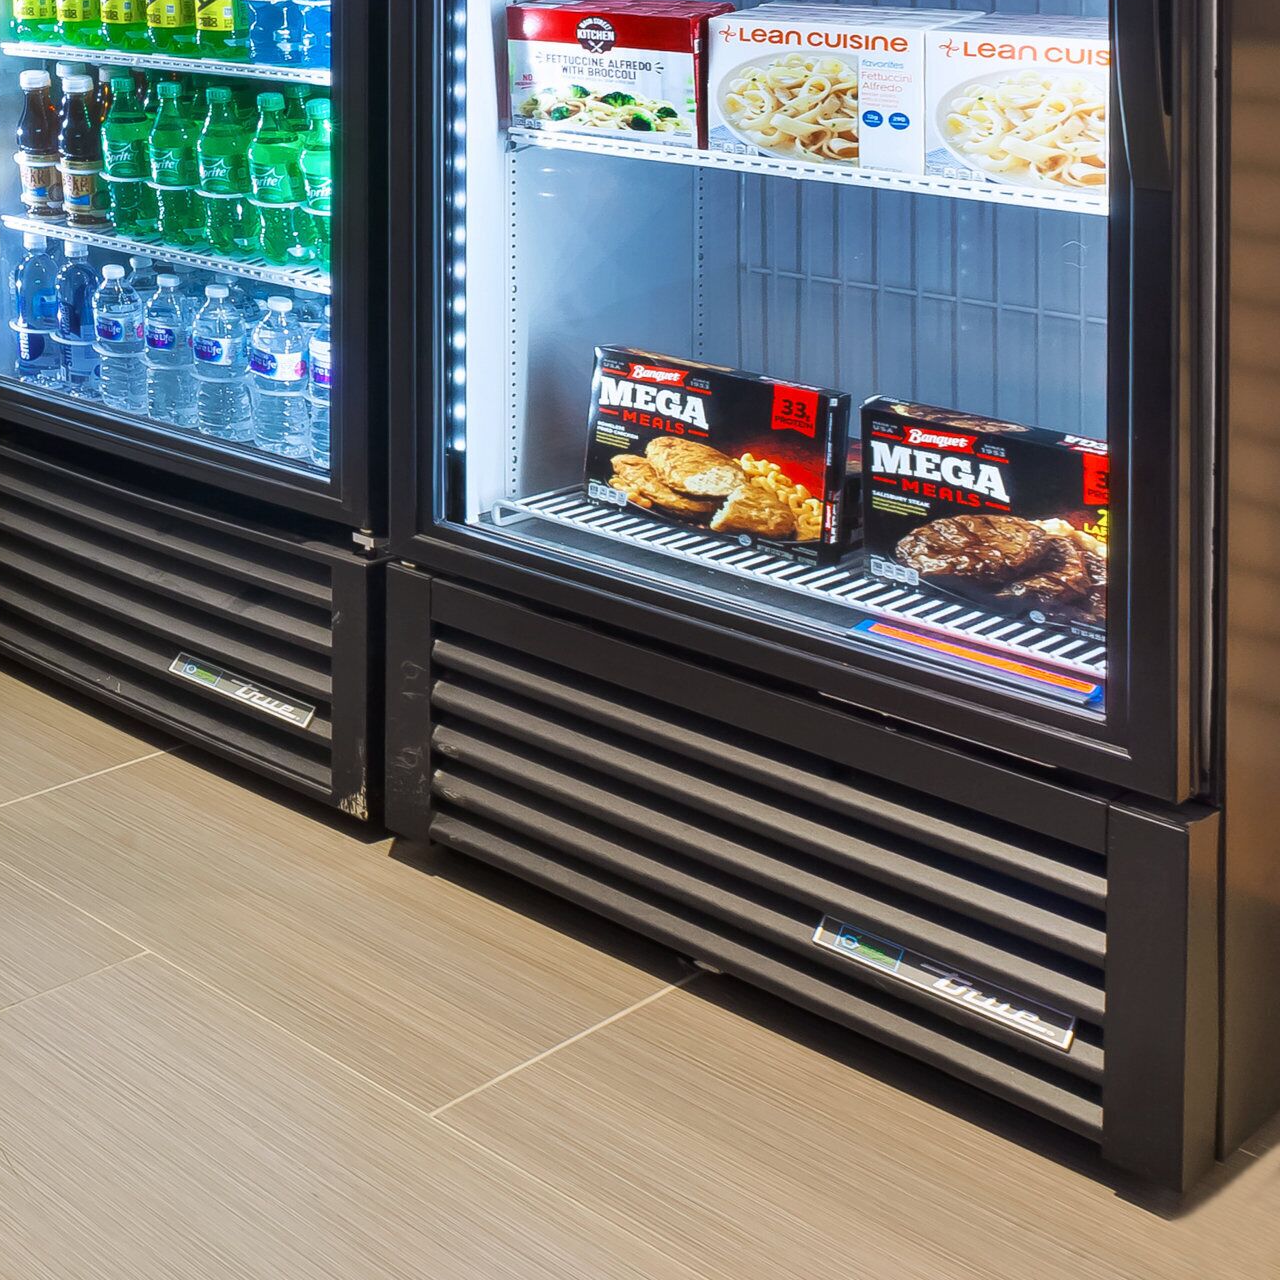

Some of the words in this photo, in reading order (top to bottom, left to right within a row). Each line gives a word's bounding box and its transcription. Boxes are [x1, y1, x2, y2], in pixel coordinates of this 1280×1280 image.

[577, 29, 614, 40] KITCHEN
[740, 27, 802, 45] Lean
[964, 41, 1037, 61] Lean
[546, 54, 604, 67] FETTUCCINE
[609, 60, 651, 71] ALFREDO
[862, 59, 904, 69] favorites
[562, 65, 583, 75] WITH
[588, 67, 636, 79] BROCCOLI
[862, 72, 912, 83] Fettuccini
[862, 82, 903, 93] Alfredo
[632, 365, 681, 382] Banquet
[599, 376, 709, 430] MEGA
[623, 409, 685, 435] MEALS
[774, 416, 814, 430] PROTEIN
[906, 429, 968, 448] Banquet
[871, 440, 1010, 503] MEGA
[901, 478, 981, 507] MEALS
